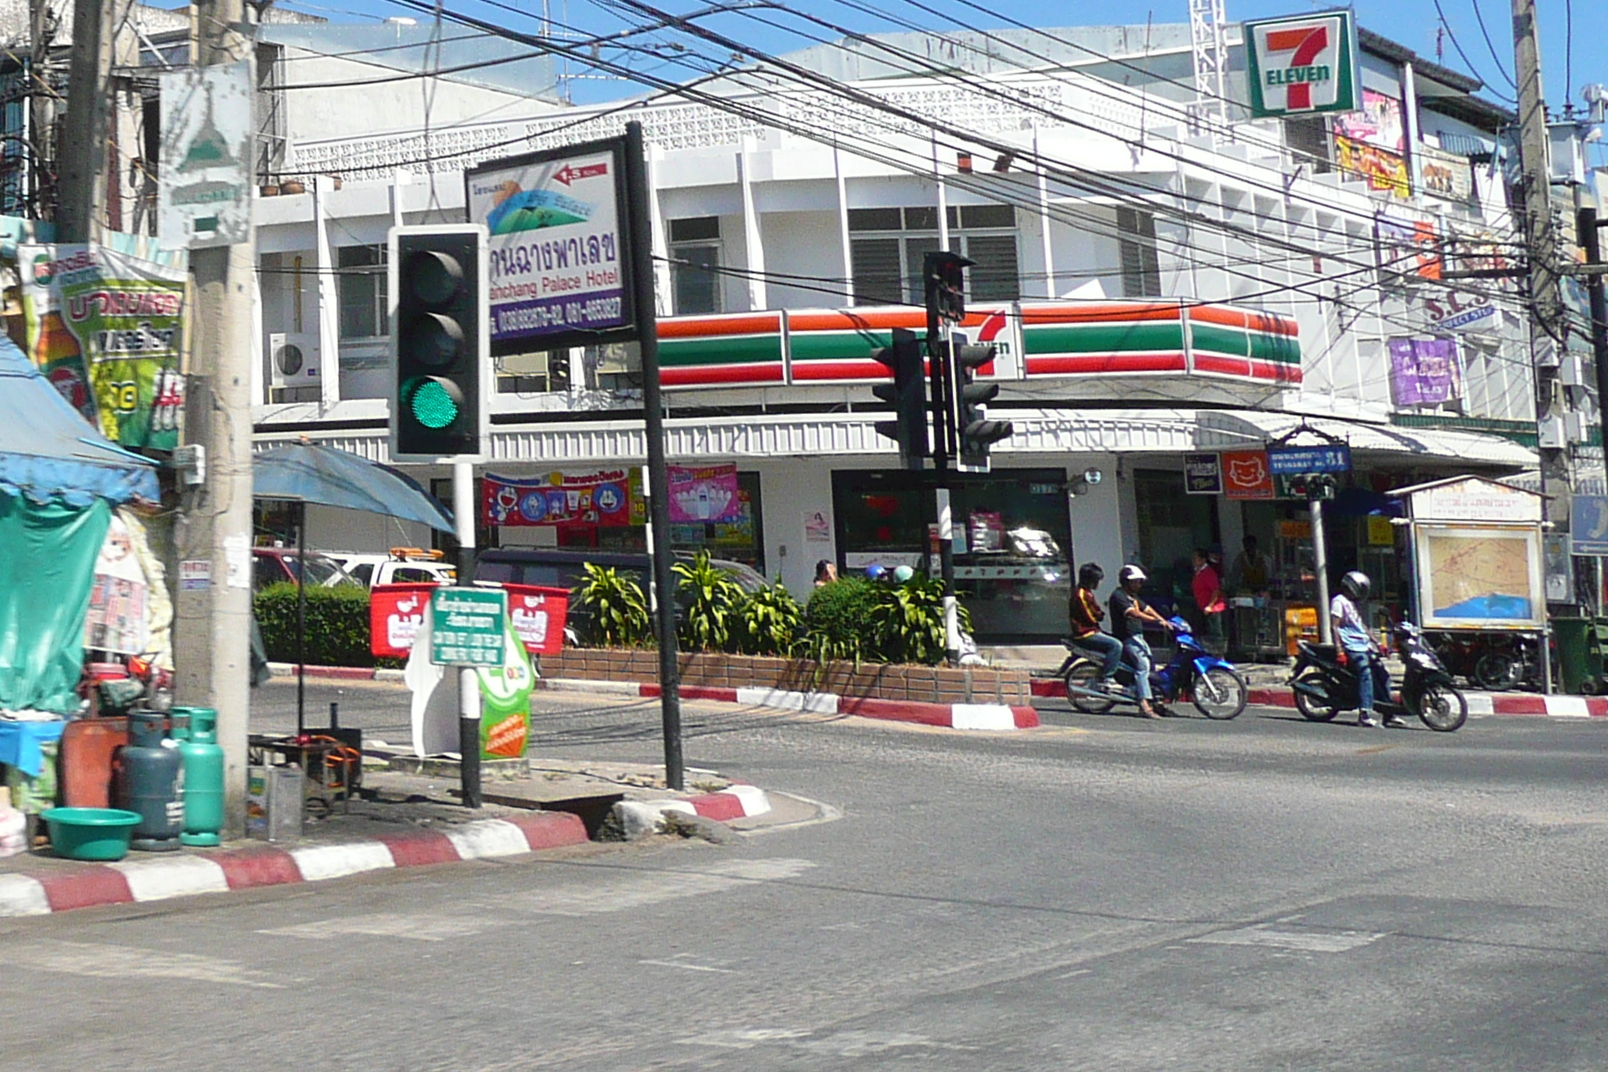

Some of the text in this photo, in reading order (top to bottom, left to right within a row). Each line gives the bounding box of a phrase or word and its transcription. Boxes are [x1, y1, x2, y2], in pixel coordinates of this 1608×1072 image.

[560, 167, 581, 181] 1.5
[490, 232, 616, 277] านฉางพาเลซ
[489, 267, 618, 299] anchang Palace Hotel
